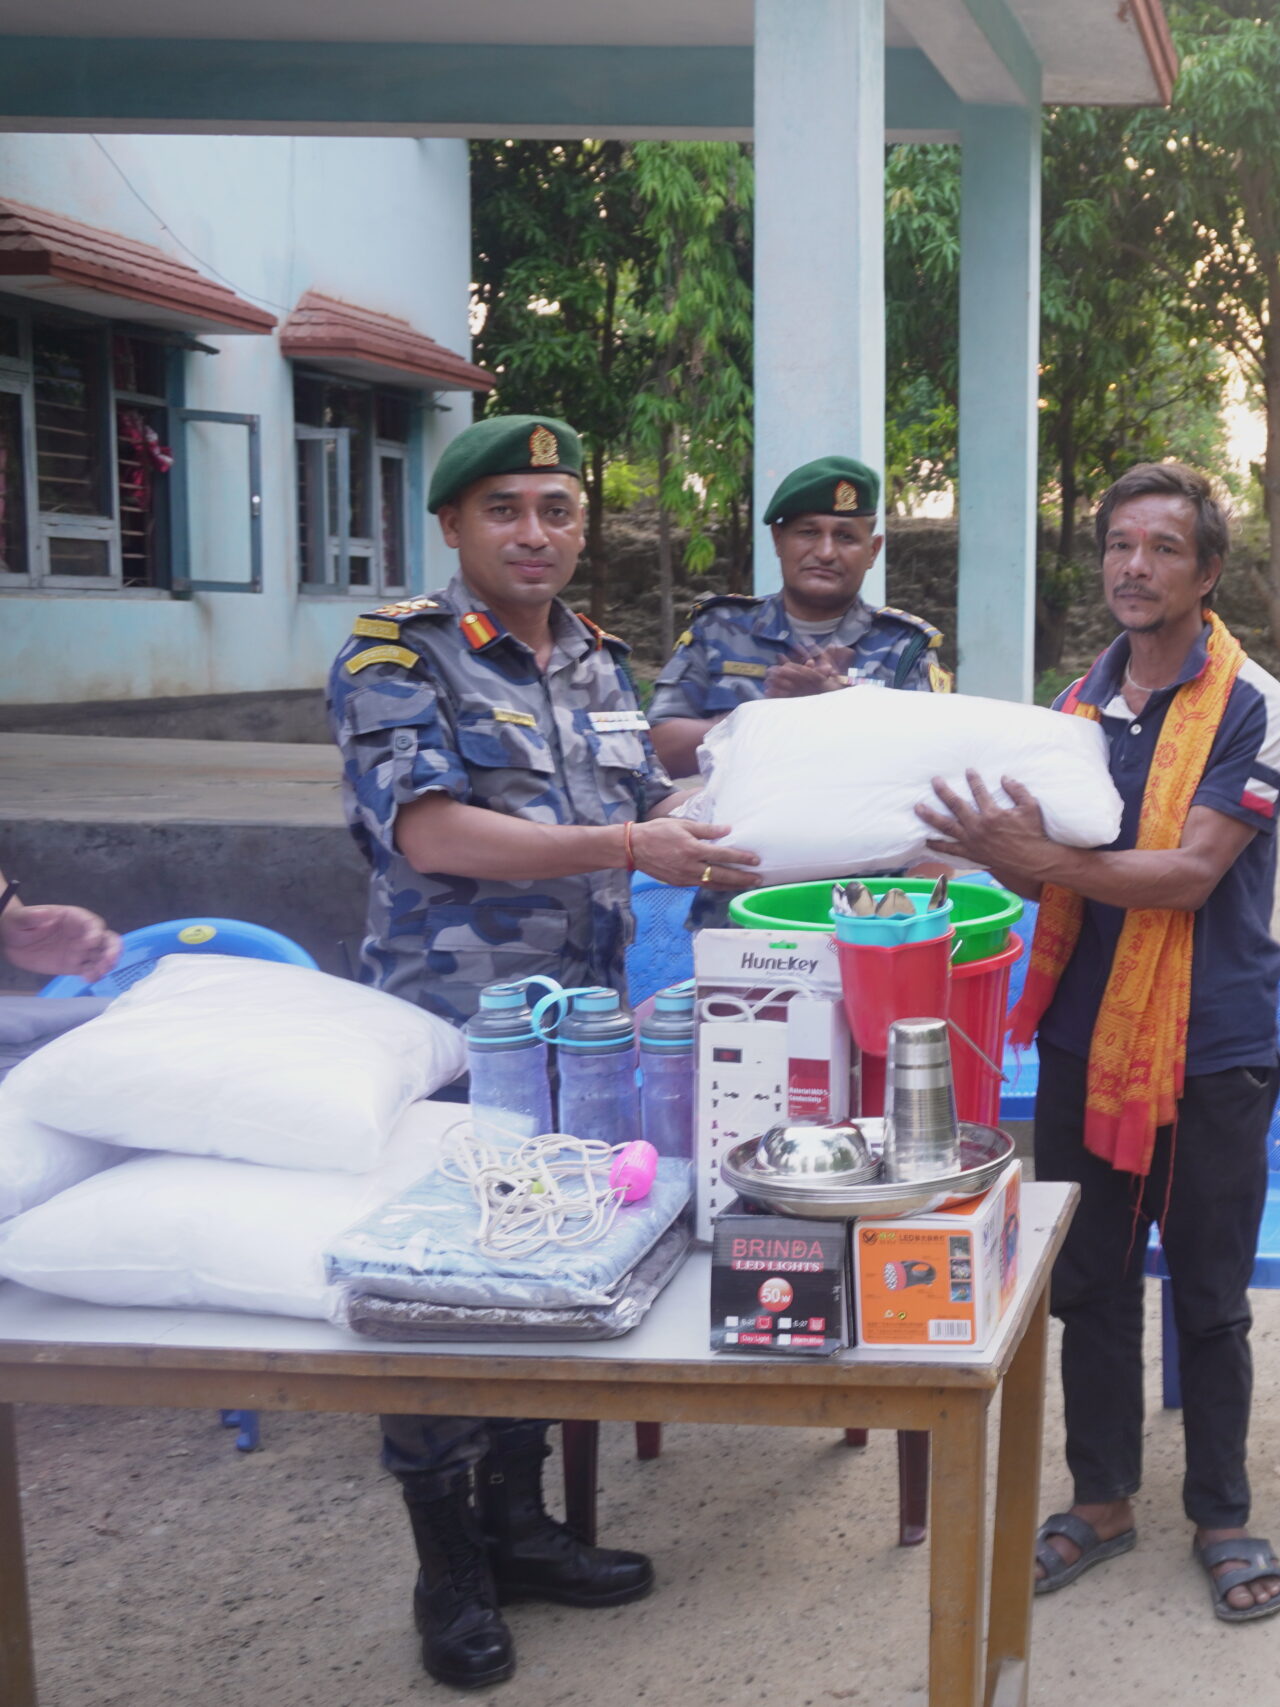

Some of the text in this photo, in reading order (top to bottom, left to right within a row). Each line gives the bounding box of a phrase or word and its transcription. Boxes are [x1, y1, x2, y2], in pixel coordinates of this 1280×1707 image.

[732, 1238, 824, 1259] BRINDA
[735, 1259, 821, 1273] LED LIGHTS
